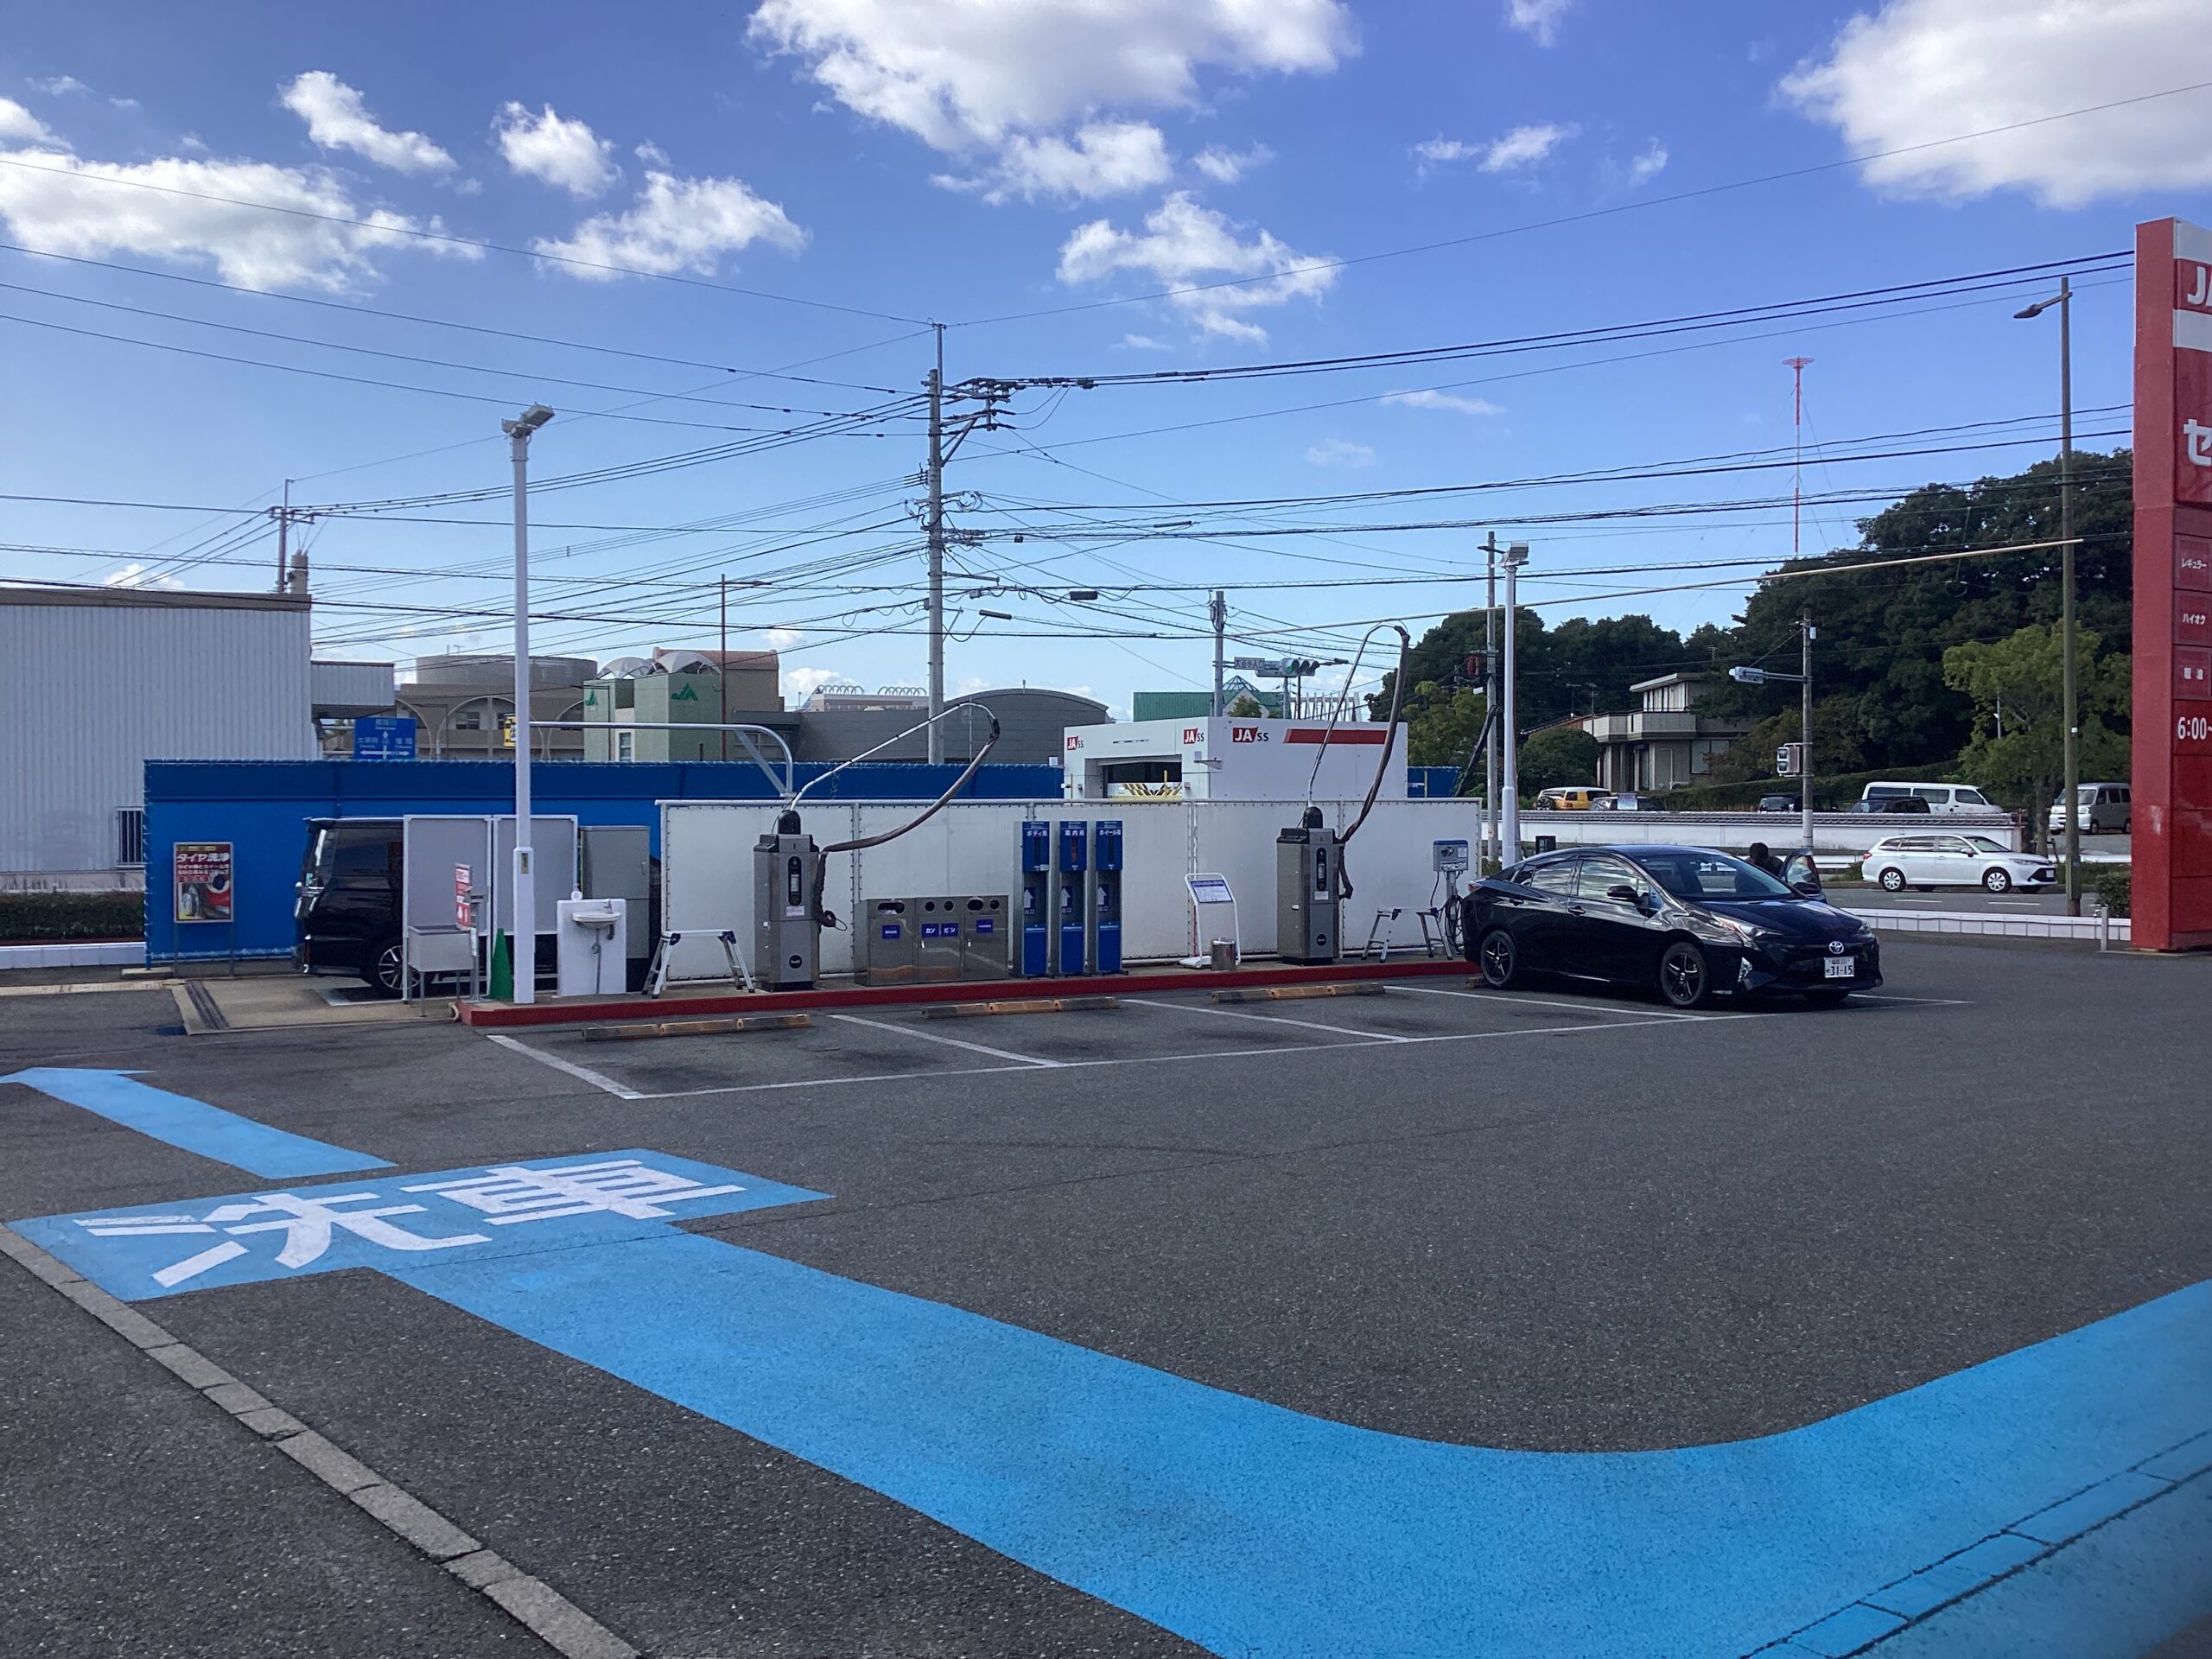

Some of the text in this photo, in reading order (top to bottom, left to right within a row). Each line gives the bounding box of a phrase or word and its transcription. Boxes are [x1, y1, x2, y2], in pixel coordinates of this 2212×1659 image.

[2188, 266, 2212, 305] J
[2181, 557, 2208, 569] レギュラー
[2183, 613, 2206, 625] ハイオク
[176, 852, 230, 862] タイヤ洗浄
[1831, 965, 1853, 976] 31-15
[72, 1159, 748, 1288] 洗車
